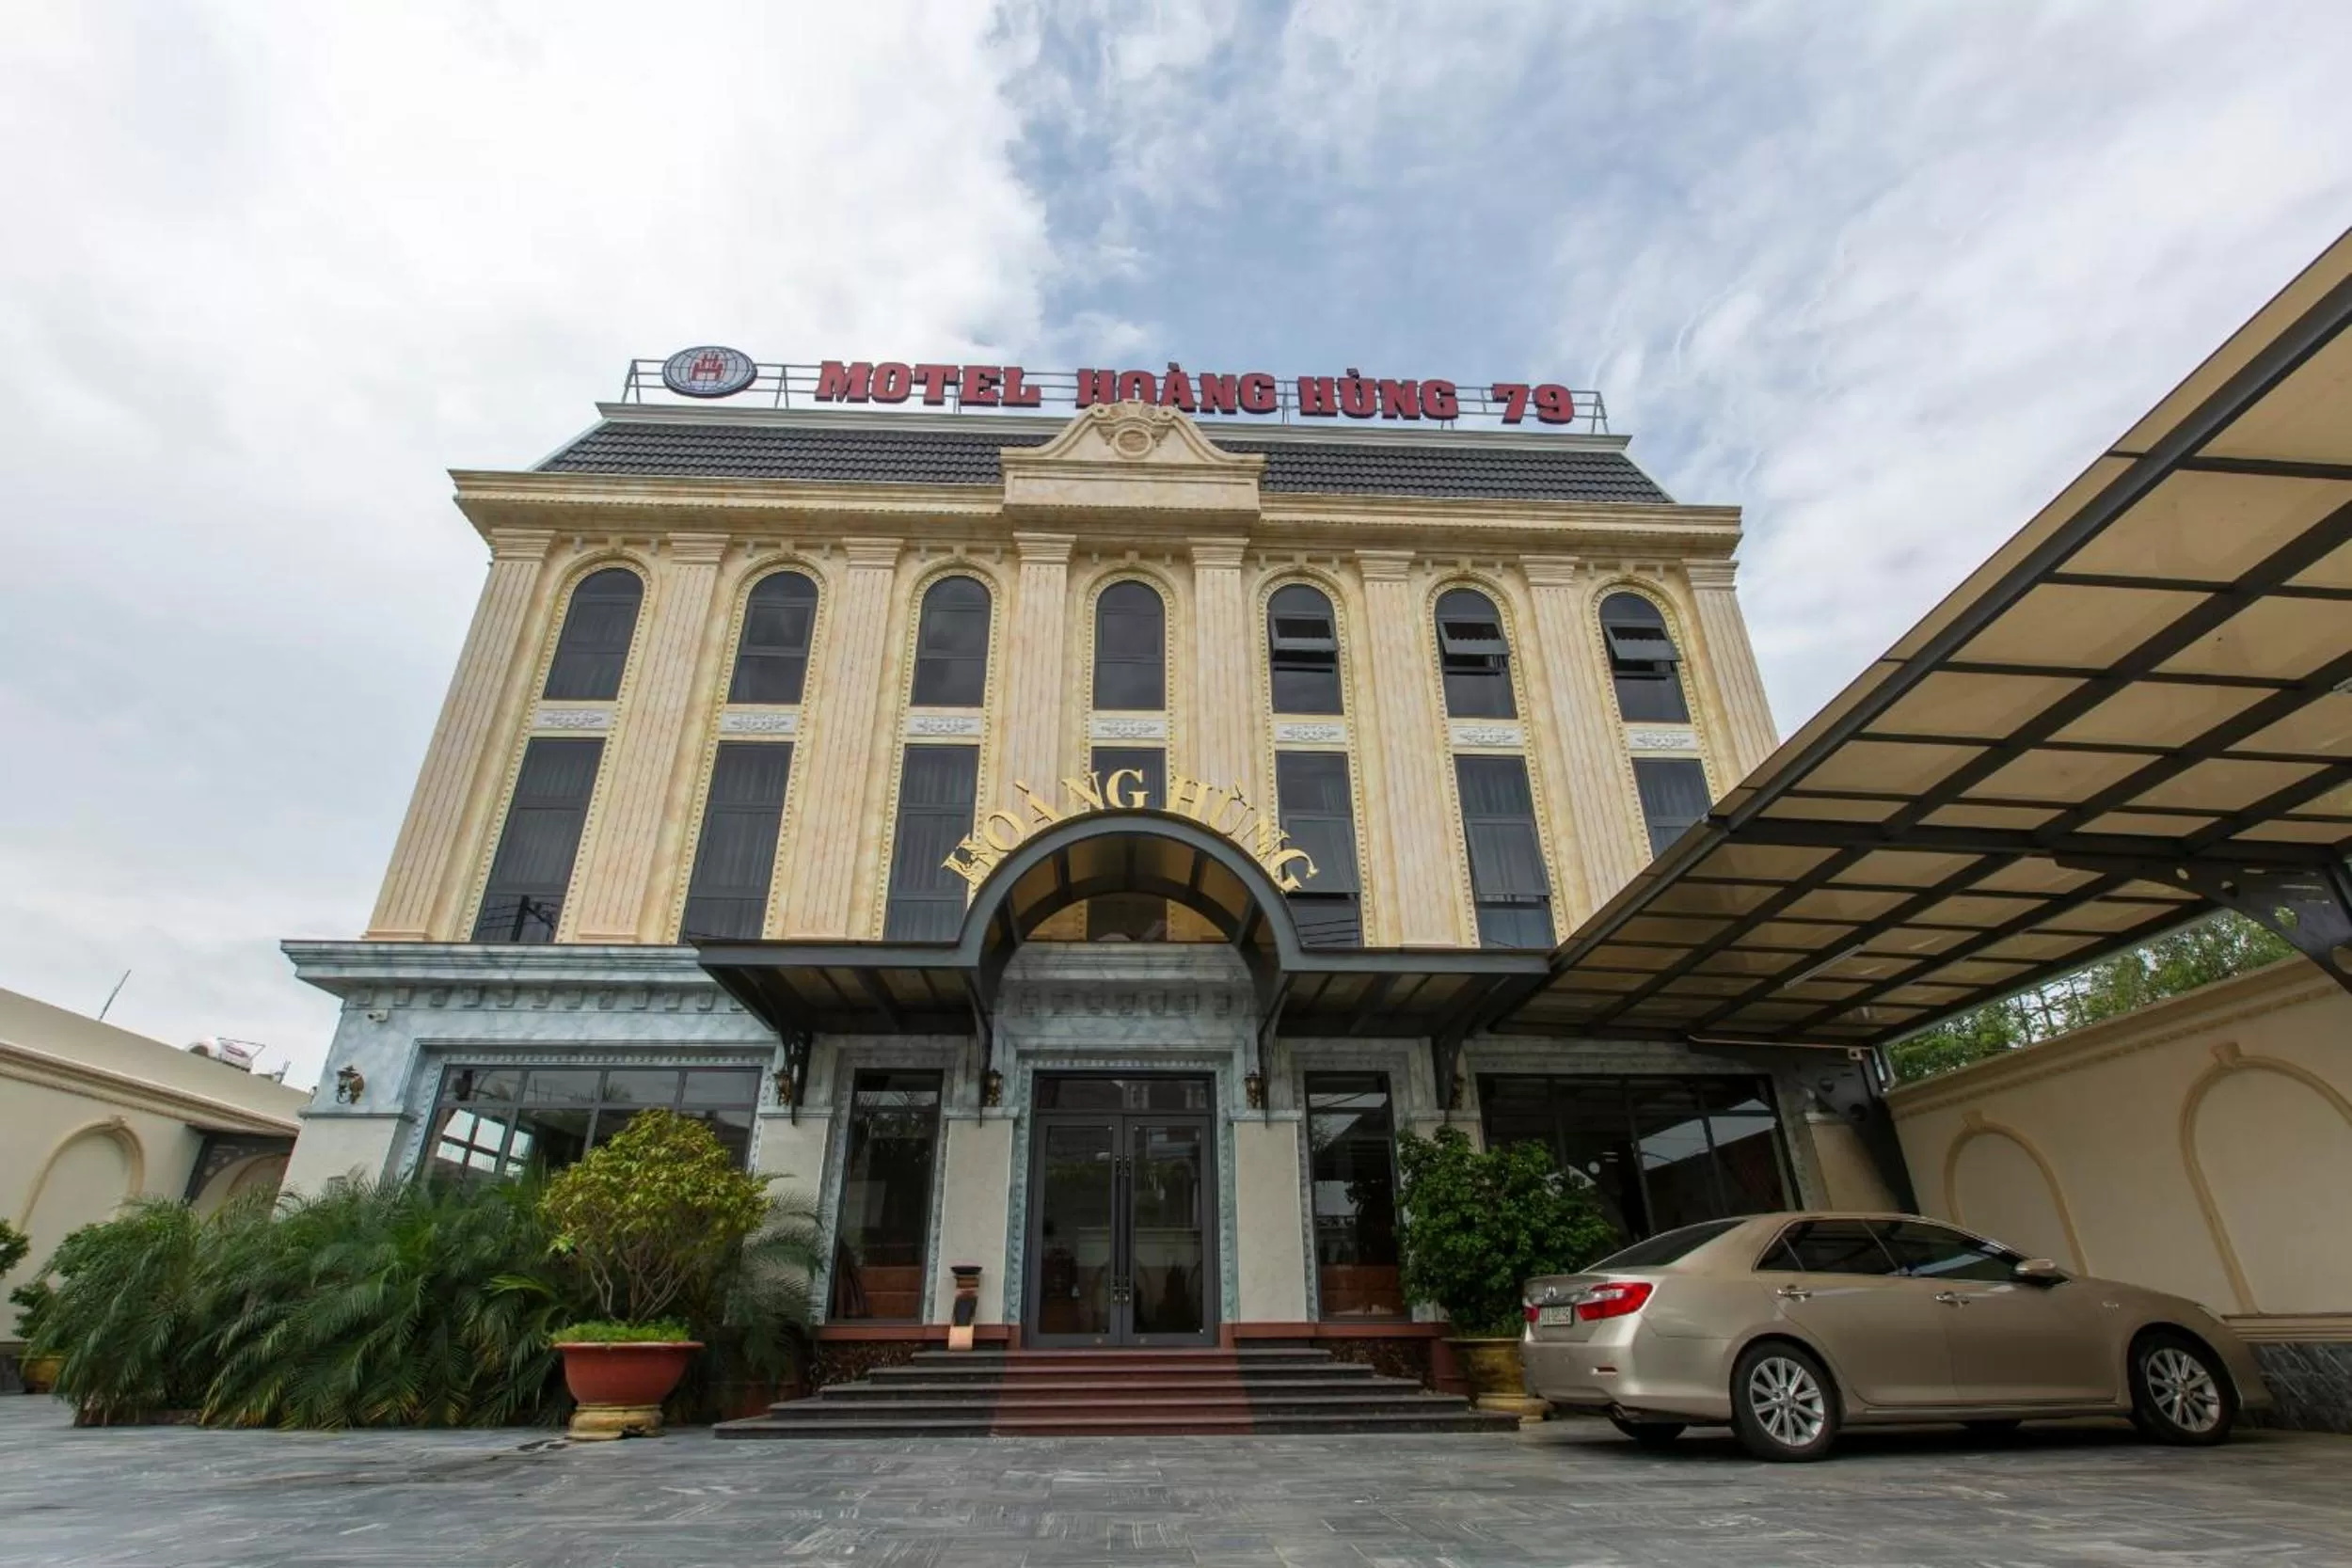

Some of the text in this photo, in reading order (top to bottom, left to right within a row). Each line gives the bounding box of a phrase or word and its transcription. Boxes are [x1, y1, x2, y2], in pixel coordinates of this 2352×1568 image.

[815, 360, 1575, 424] MOTEL HOÀNG HÙNG 79
